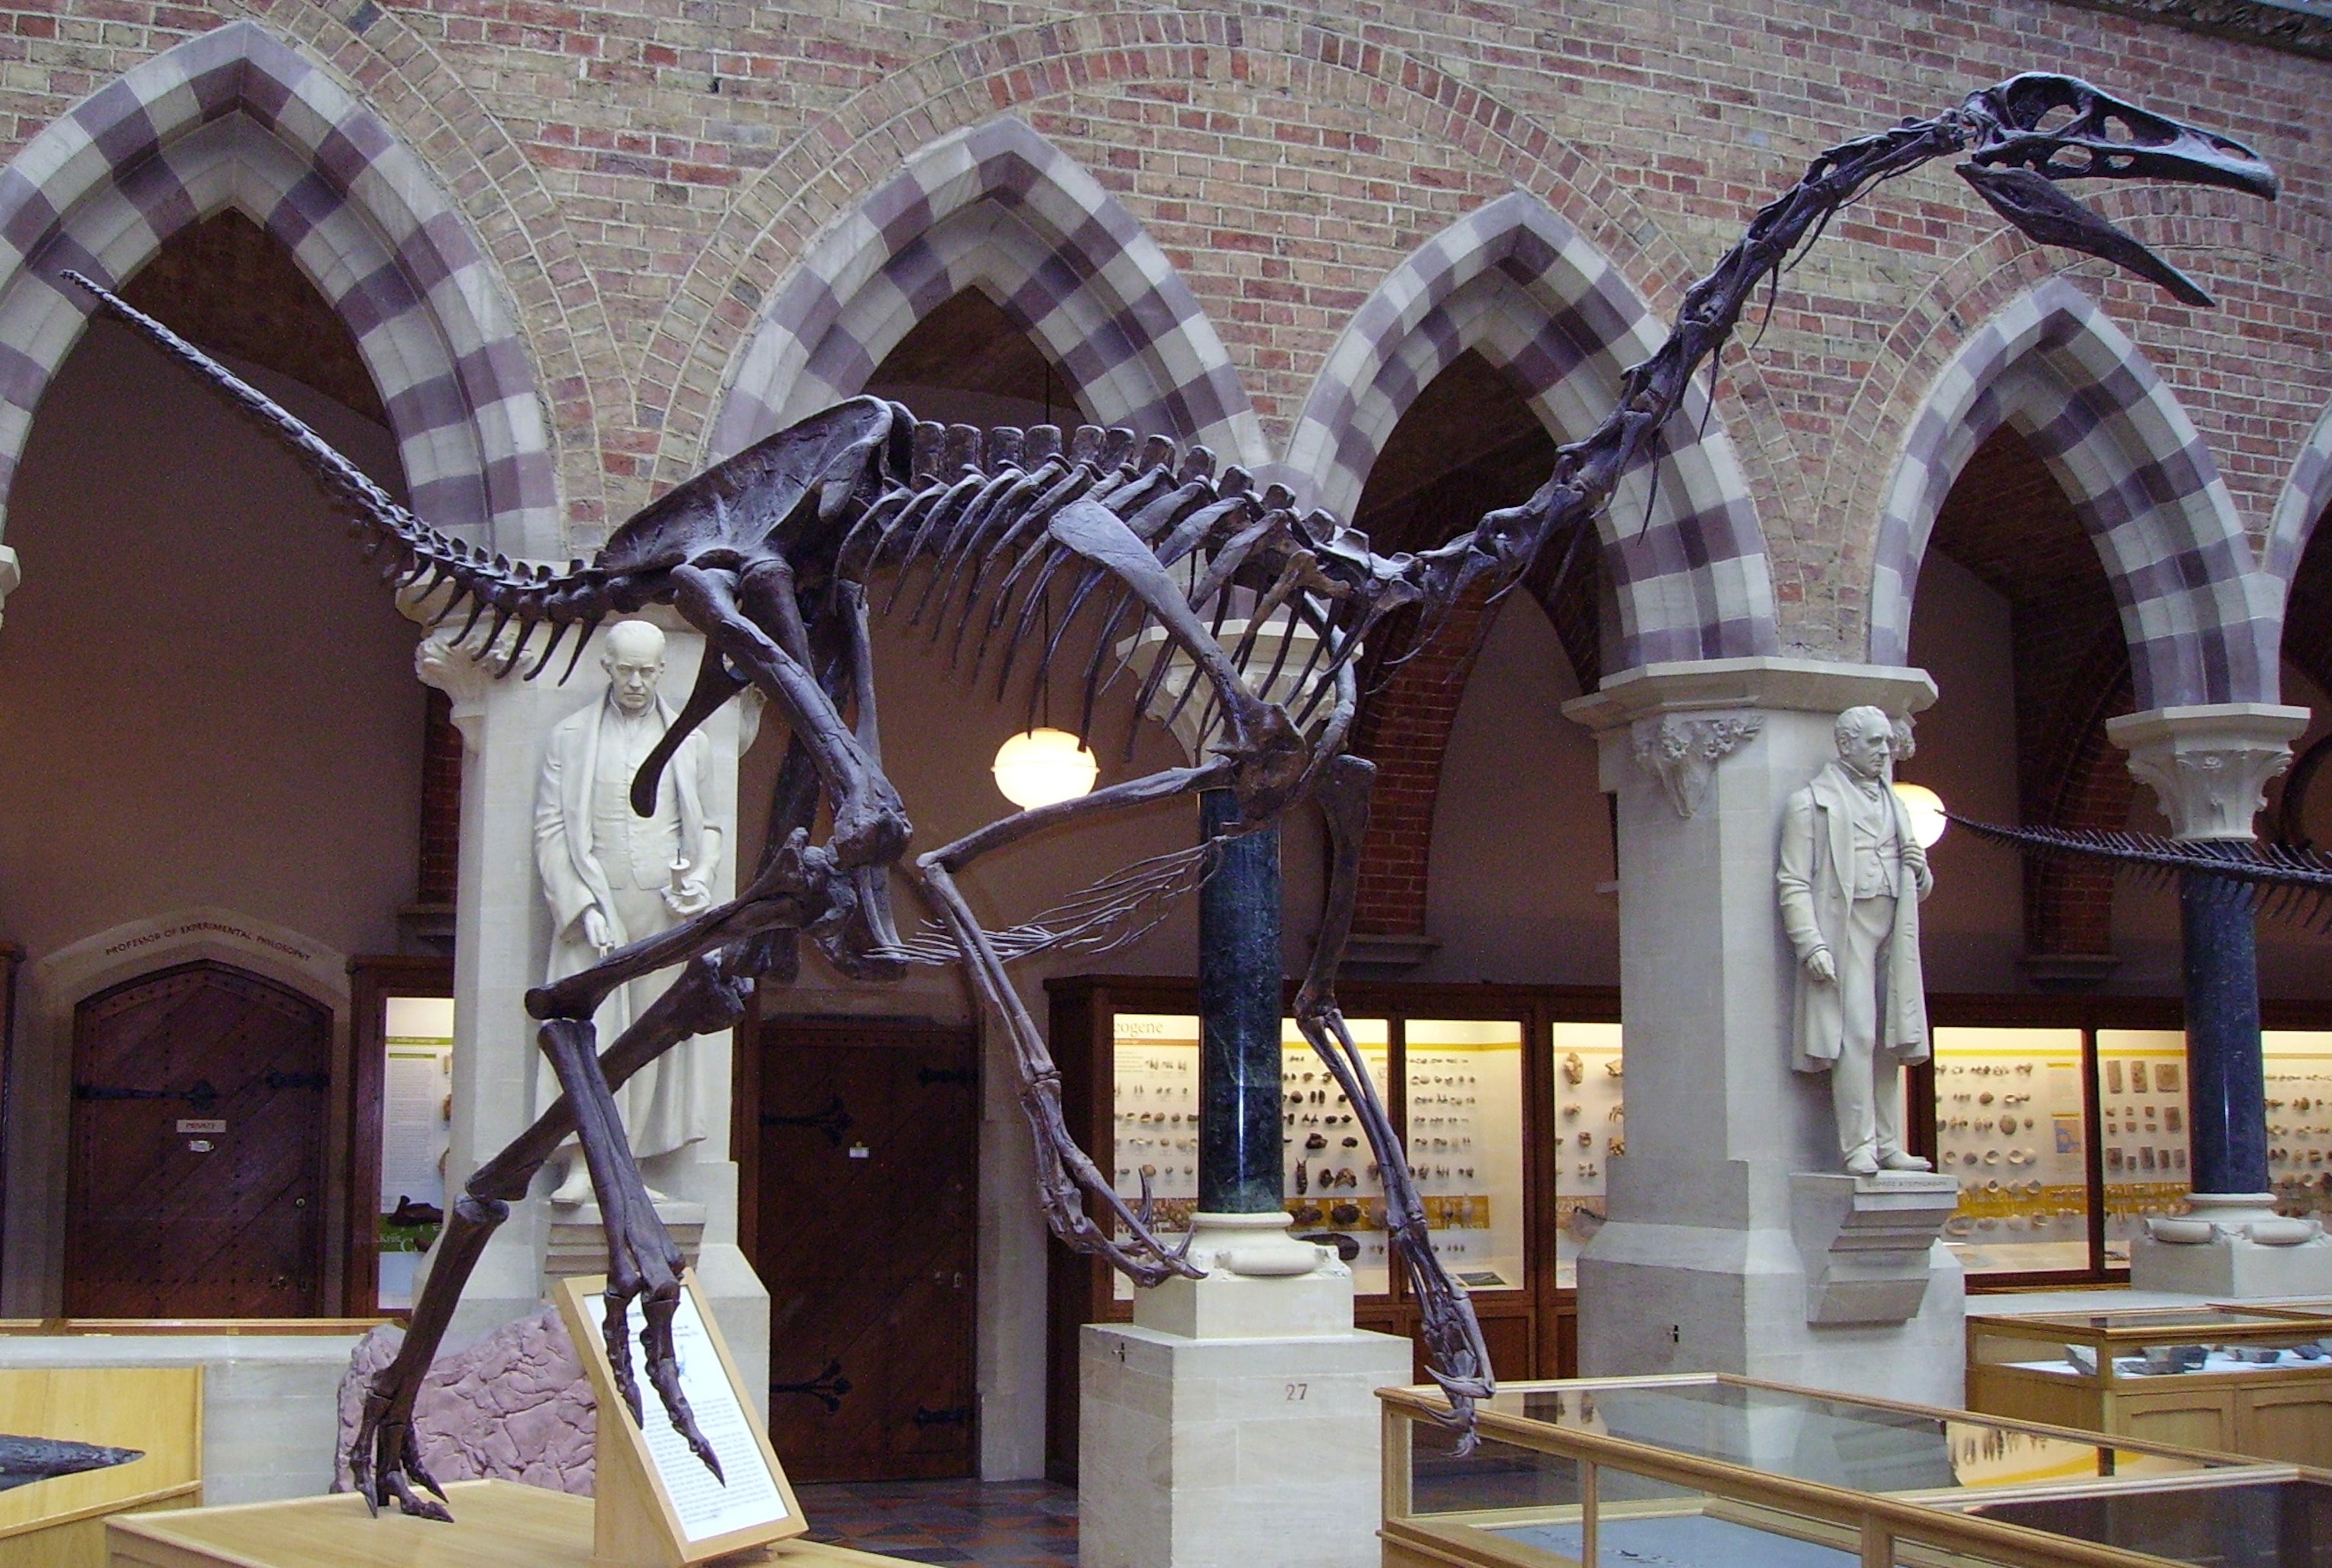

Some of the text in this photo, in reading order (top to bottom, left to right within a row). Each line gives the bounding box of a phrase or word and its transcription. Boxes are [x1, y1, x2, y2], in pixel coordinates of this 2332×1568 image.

[106, 922, 310, 961] PROFESSOR OF EXPERIMENTAL PHILOSOPHY
[1285, 1383, 1307, 1400] 27
